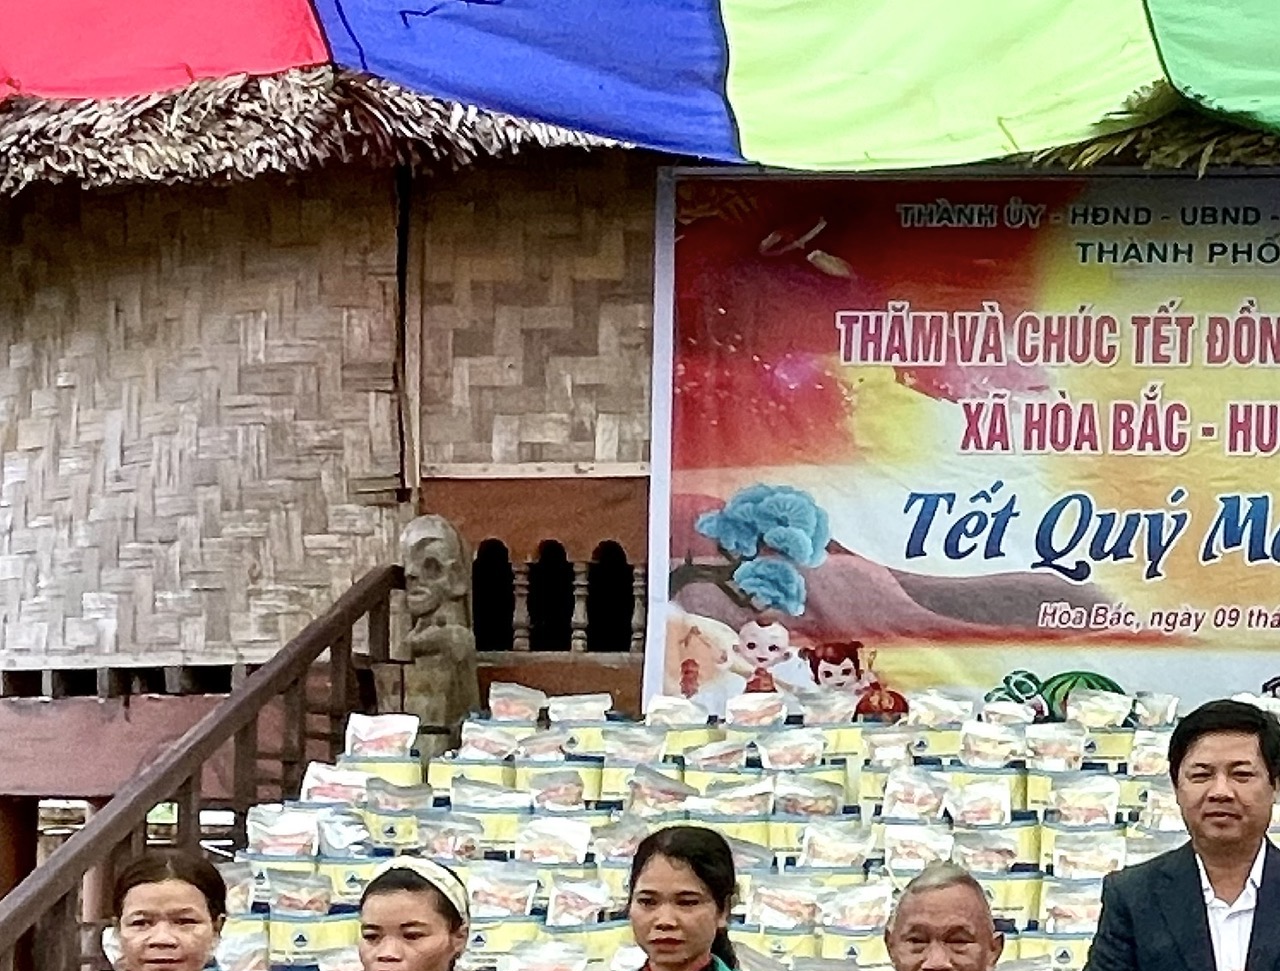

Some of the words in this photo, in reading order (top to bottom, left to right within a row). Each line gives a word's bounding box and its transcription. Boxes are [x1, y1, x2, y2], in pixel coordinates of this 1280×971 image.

[897, 198, 996, 227] THÀNH
[1004, 197, 1045, 227] ỦY
[1071, 206, 1152, 226] HĐND
[1180, 206, 1261, 226] UBND
[1076, 236, 1194, 264] THÀNH
[1208, 232, 1280, 264] PHỐ
[839, 301, 944, 363] THĂM
[958, 302, 1004, 363] VÀ
[1018, 305, 1118, 363] CHÚC
[1131, 299, 1195, 363] TẾT
[961, 393, 1010, 451] XÃ
[1024, 390, 1098, 451] HÒA
[1113, 385, 1189, 452] BẮC
[903, 480, 1019, 560] Tết
[1031, 489, 1189, 581] Quý
[1038, 600, 1089, 627] Hòa
[1149, 606, 1205, 632] ngày
[1213, 608, 1241, 628] 09
